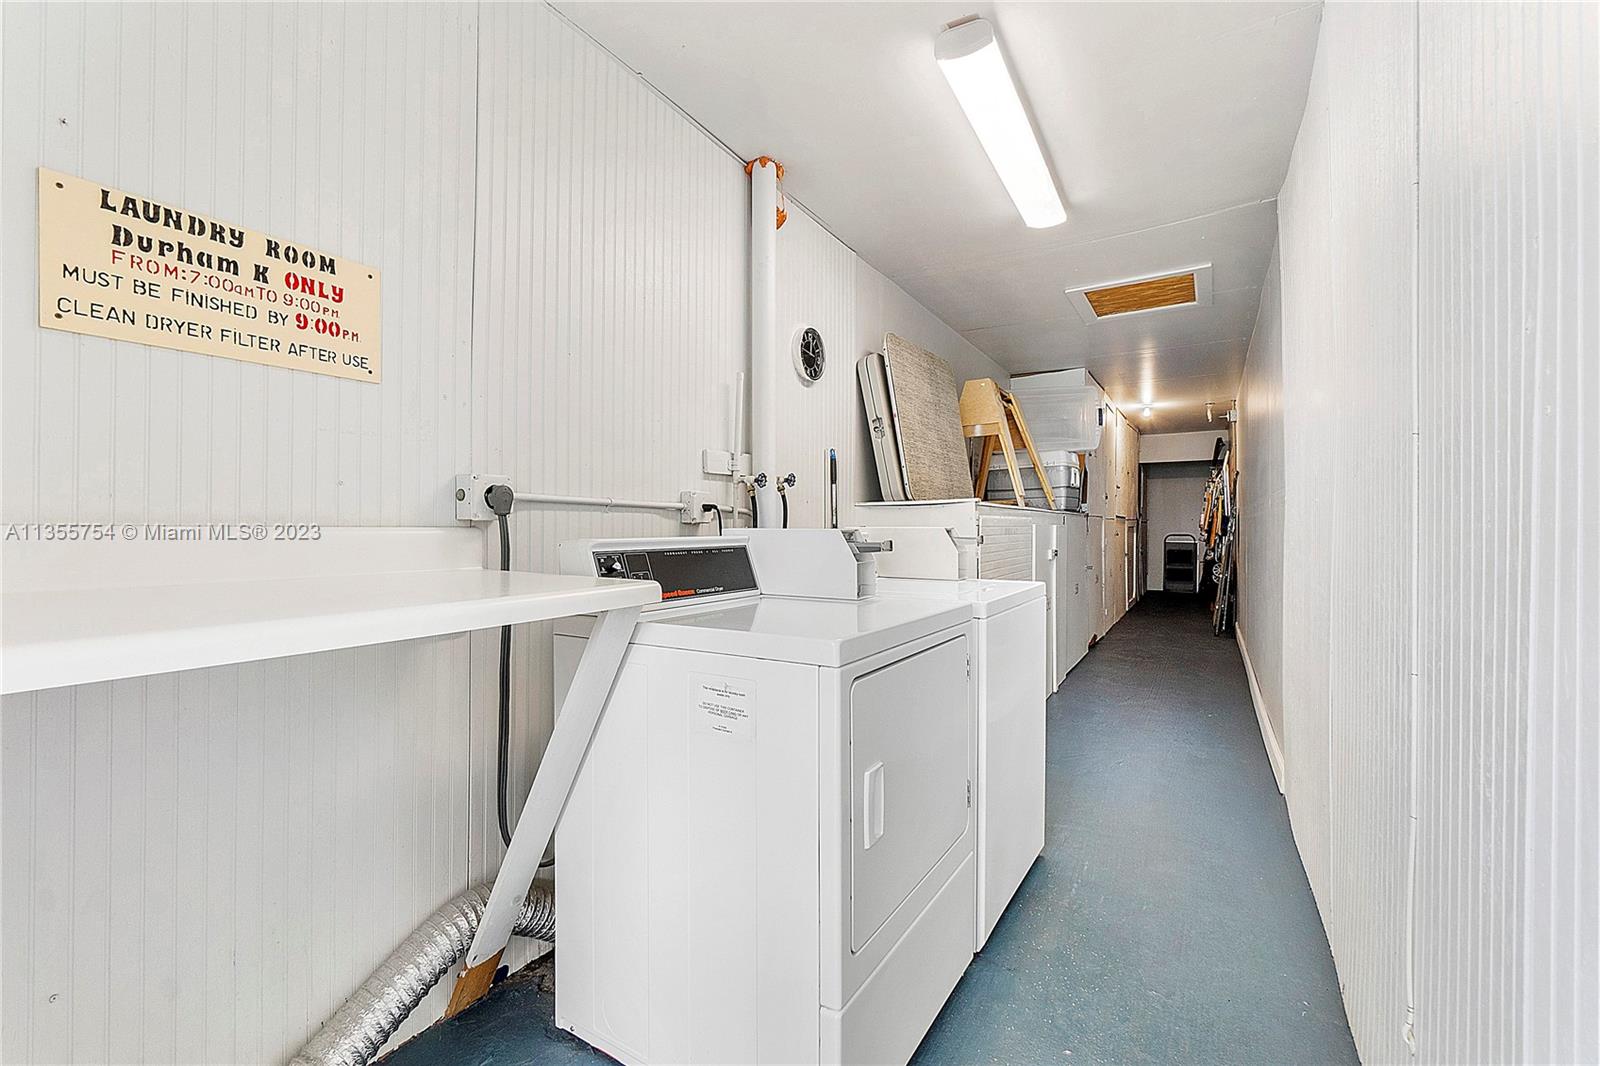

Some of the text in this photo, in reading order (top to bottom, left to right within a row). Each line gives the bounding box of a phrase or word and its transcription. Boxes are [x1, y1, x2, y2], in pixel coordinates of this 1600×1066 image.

[99, 188, 336, 275] LAUNDRY ROOM
[111, 224, 344, 303] Durham K ONLY
[62, 263, 124, 290] MUST
[133, 279, 161, 299] BE
[172, 288, 257, 320] FINISHED
[268, 310, 289, 326] BY
[57, 297, 368, 370] CLEAN DRYER FILTER AFTER USE
